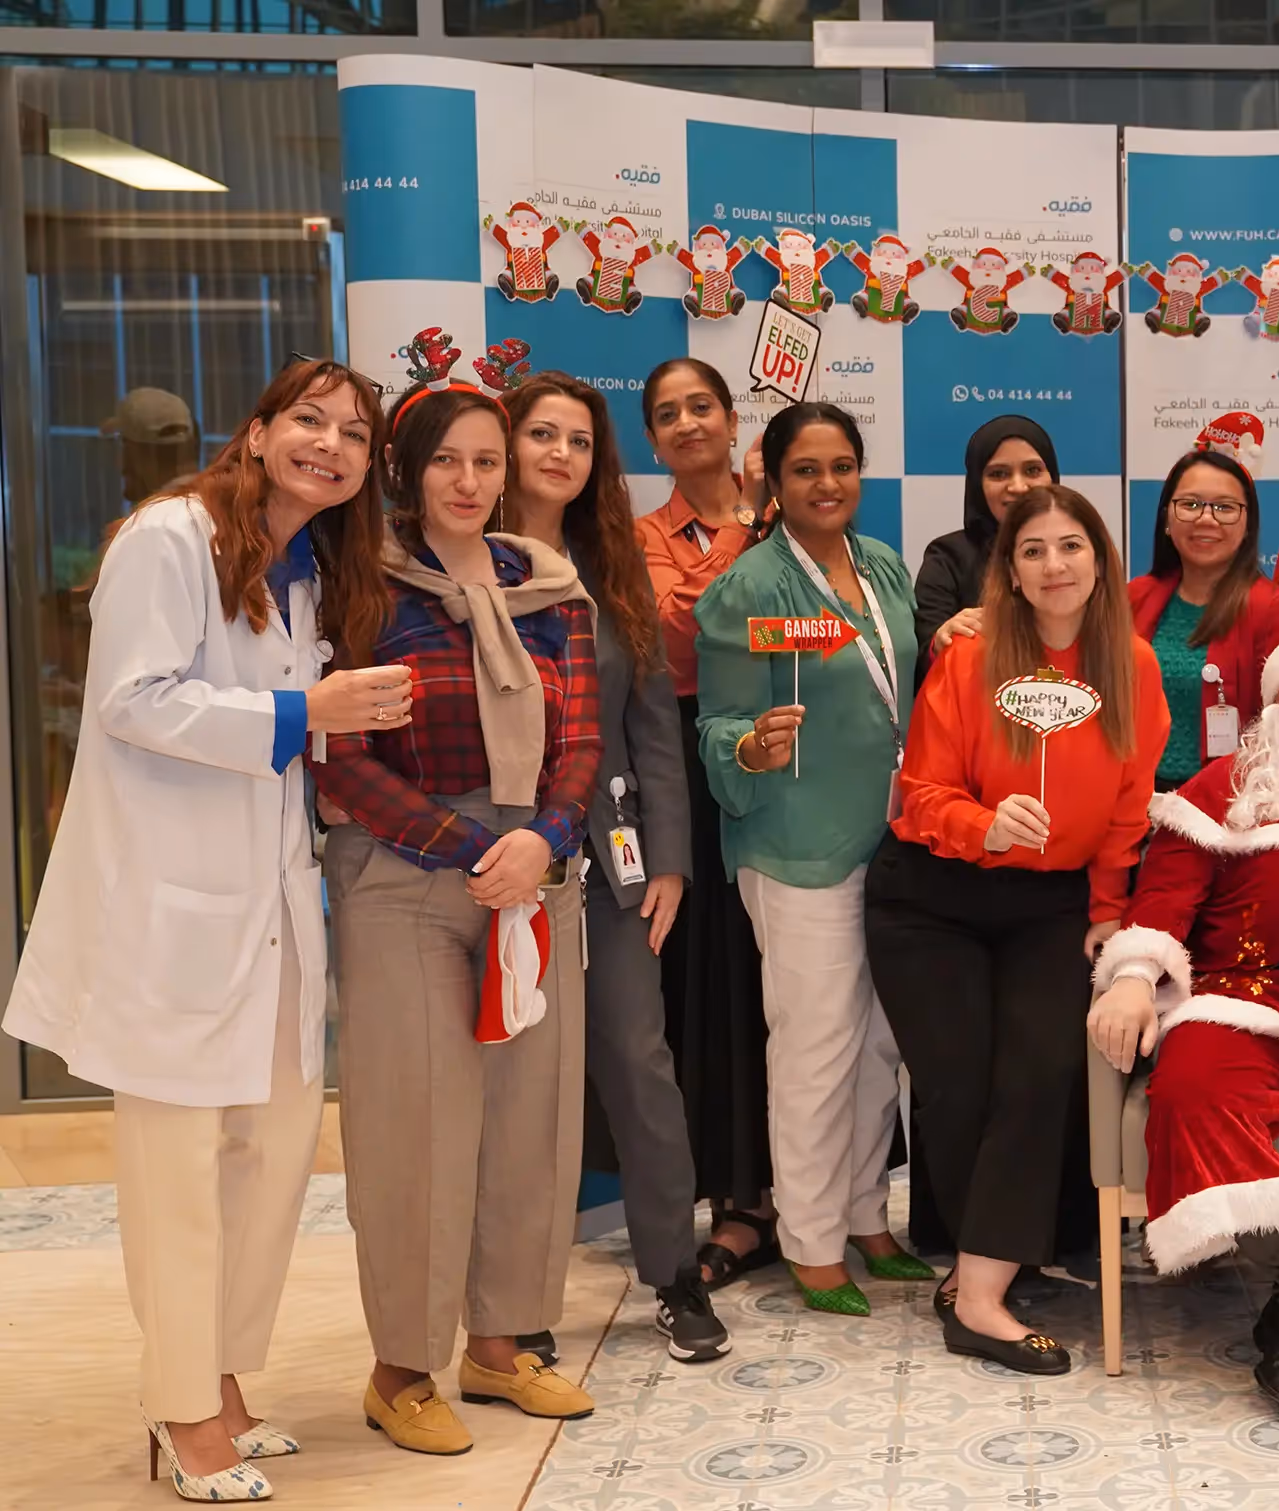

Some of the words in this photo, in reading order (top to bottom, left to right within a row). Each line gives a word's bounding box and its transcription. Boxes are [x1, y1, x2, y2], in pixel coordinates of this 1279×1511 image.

[350, 177, 369, 191] 414
[374, 176, 393, 189] 44
[399, 176, 419, 189] 44
[732, 207, 772, 222] DUBAI
[776, 211, 826, 225] SILICON
[830, 214, 872, 227] OASIS
[772, 311, 797, 333] LET'S
[796, 325, 812, 343] GET
[767, 325, 809, 361] ELFED
[762, 343, 804, 394] UP!
[988, 389, 1004, 401] 04
[1008, 389, 1032, 401] 414
[1036, 389, 1052, 401] 44
[1056, 389, 1073, 401] 44
[1154, 417, 1199, 429] Fakeeh
[784, 619, 841, 638] GANGSTA
[793, 637, 833, 649] WRAPPER
[1015, 705, 1045, 718] NEW
